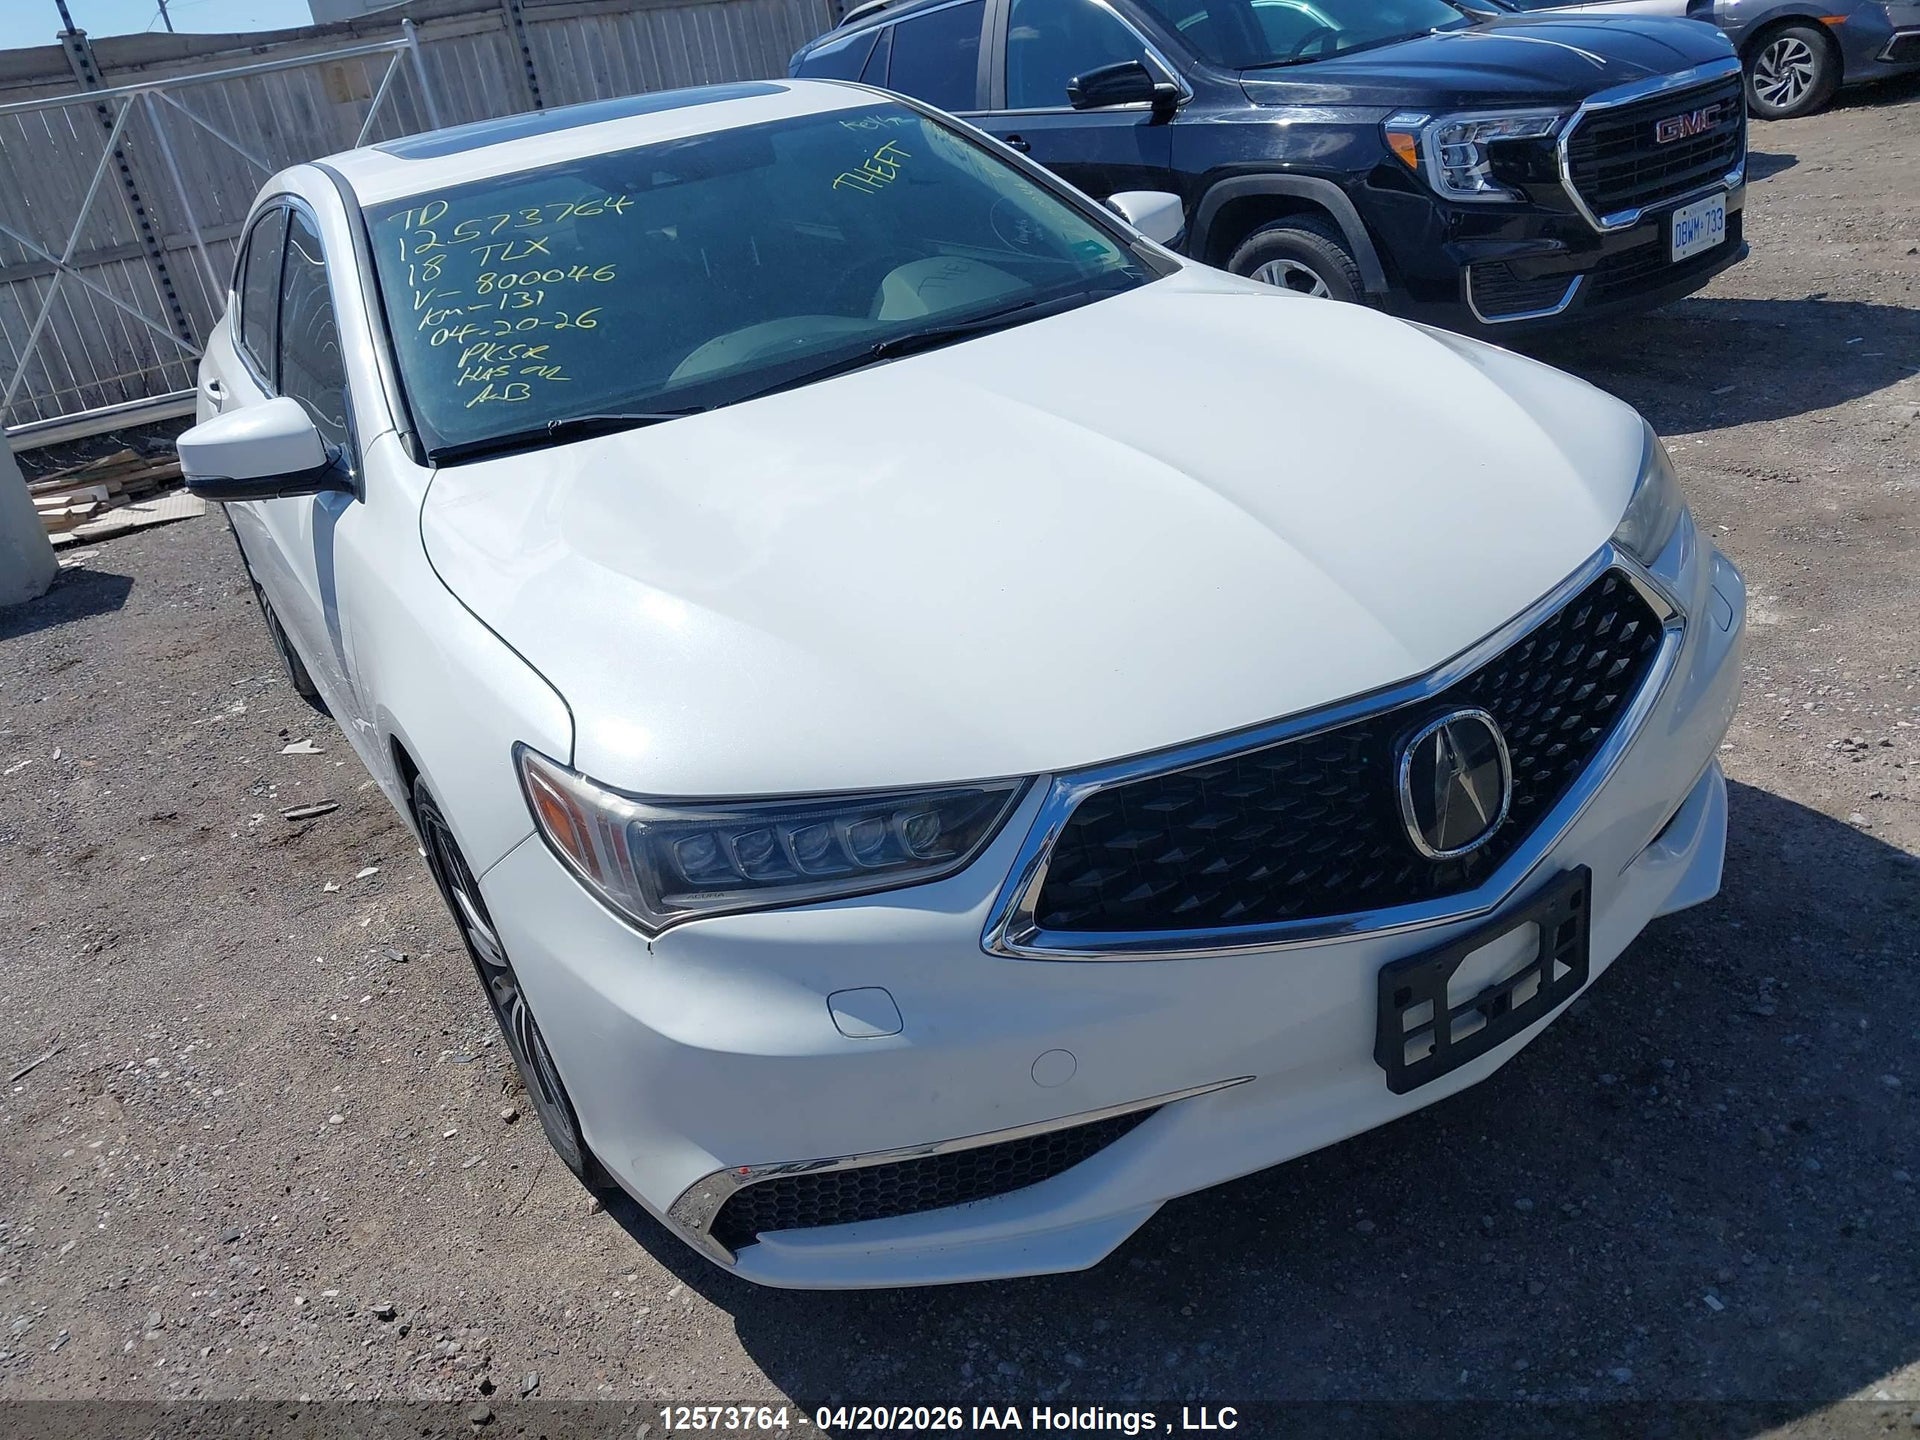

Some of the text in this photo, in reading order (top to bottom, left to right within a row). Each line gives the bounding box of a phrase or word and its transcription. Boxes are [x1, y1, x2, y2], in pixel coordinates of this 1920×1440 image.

[1656, 104, 1721, 143] GMC
[833, 140, 911, 194] THEFT
[388, 200, 448, 230] TD
[399, 195, 634, 262] 12573764
[409, 237, 551, 287] 18 TLX
[475, 264, 616, 295] 800046
